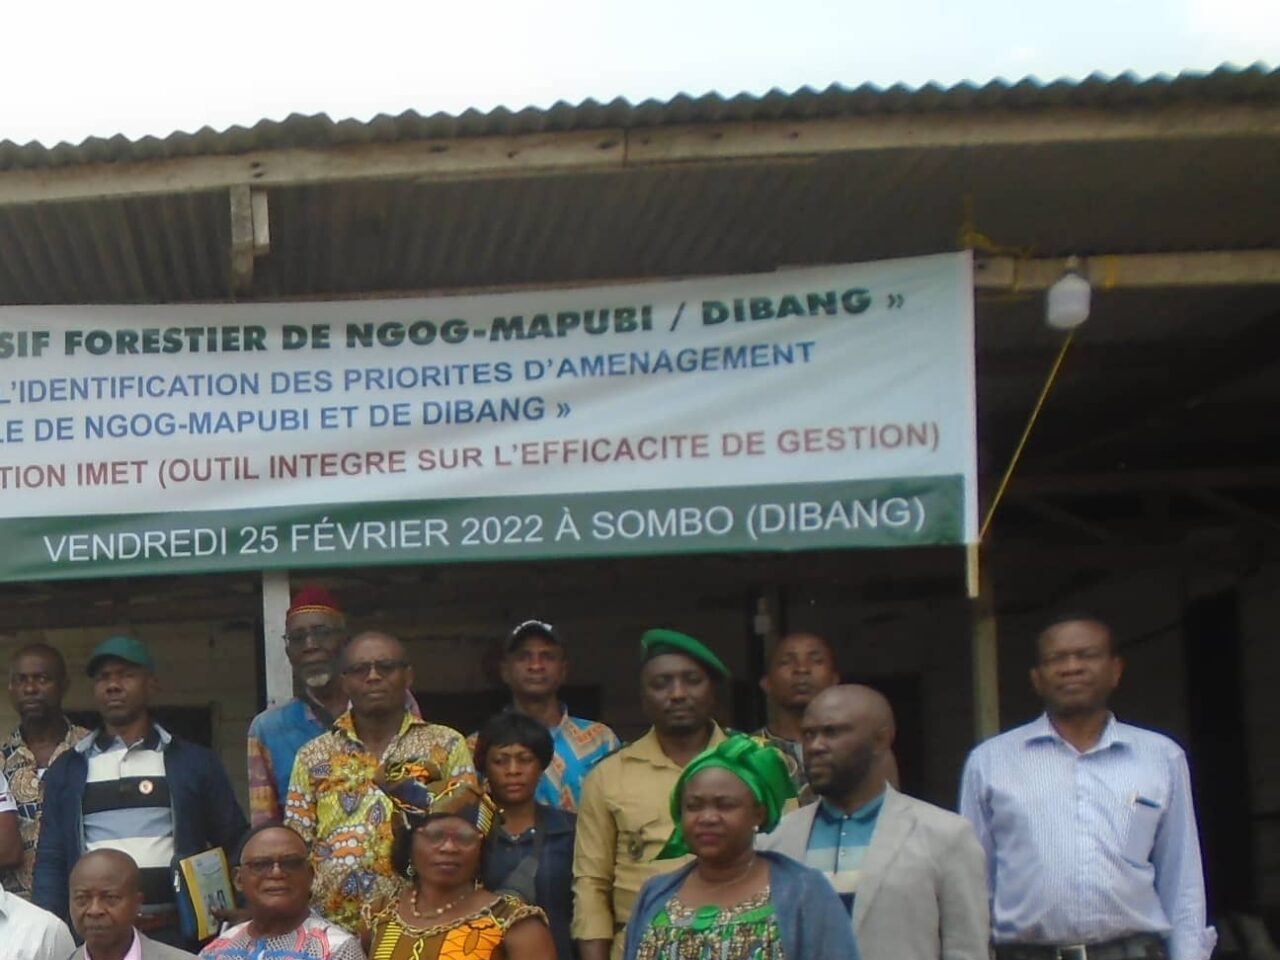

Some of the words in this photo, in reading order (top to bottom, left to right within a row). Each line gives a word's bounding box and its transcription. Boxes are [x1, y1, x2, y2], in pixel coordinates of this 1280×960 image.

[65, 321, 268, 357] FORESTIER
[282, 324, 331, 351] DE
[346, 302, 653, 349] NGOG-MAPUBI
[702, 287, 872, 327] DIBANG
[271, 370, 333, 394] DES
[344, 361, 513, 392] PRIORITES
[524, 341, 815, 381] D’AMENAGEMENT
[35, 416, 74, 442] DE
[85, 408, 308, 440] NGOG-MAPUBI
[321, 405, 359, 430] ET
[369, 403, 411, 428] DE
[423, 395, 545, 425] DIBANG
[77, 459, 148, 487] IMET
[159, 456, 260, 490] (OUTIL
[269, 450, 407, 480] INTEGRE
[418, 447, 483, 472] SUR
[495, 434, 710, 467] L’EFFICACITE
[722, 431, 765, 457] DE
[777, 422, 939, 454] GESTION)
[43, 528, 227, 562] VENDREDI
[239, 527, 279, 554] 25
[291, 517, 450, 551] FÉVRIER
[461, 514, 543, 545] 2022
[555, 507, 581, 541] À
[592, 506, 734, 540] SOMBO
[746, 497, 925, 542] (DIBANG)
